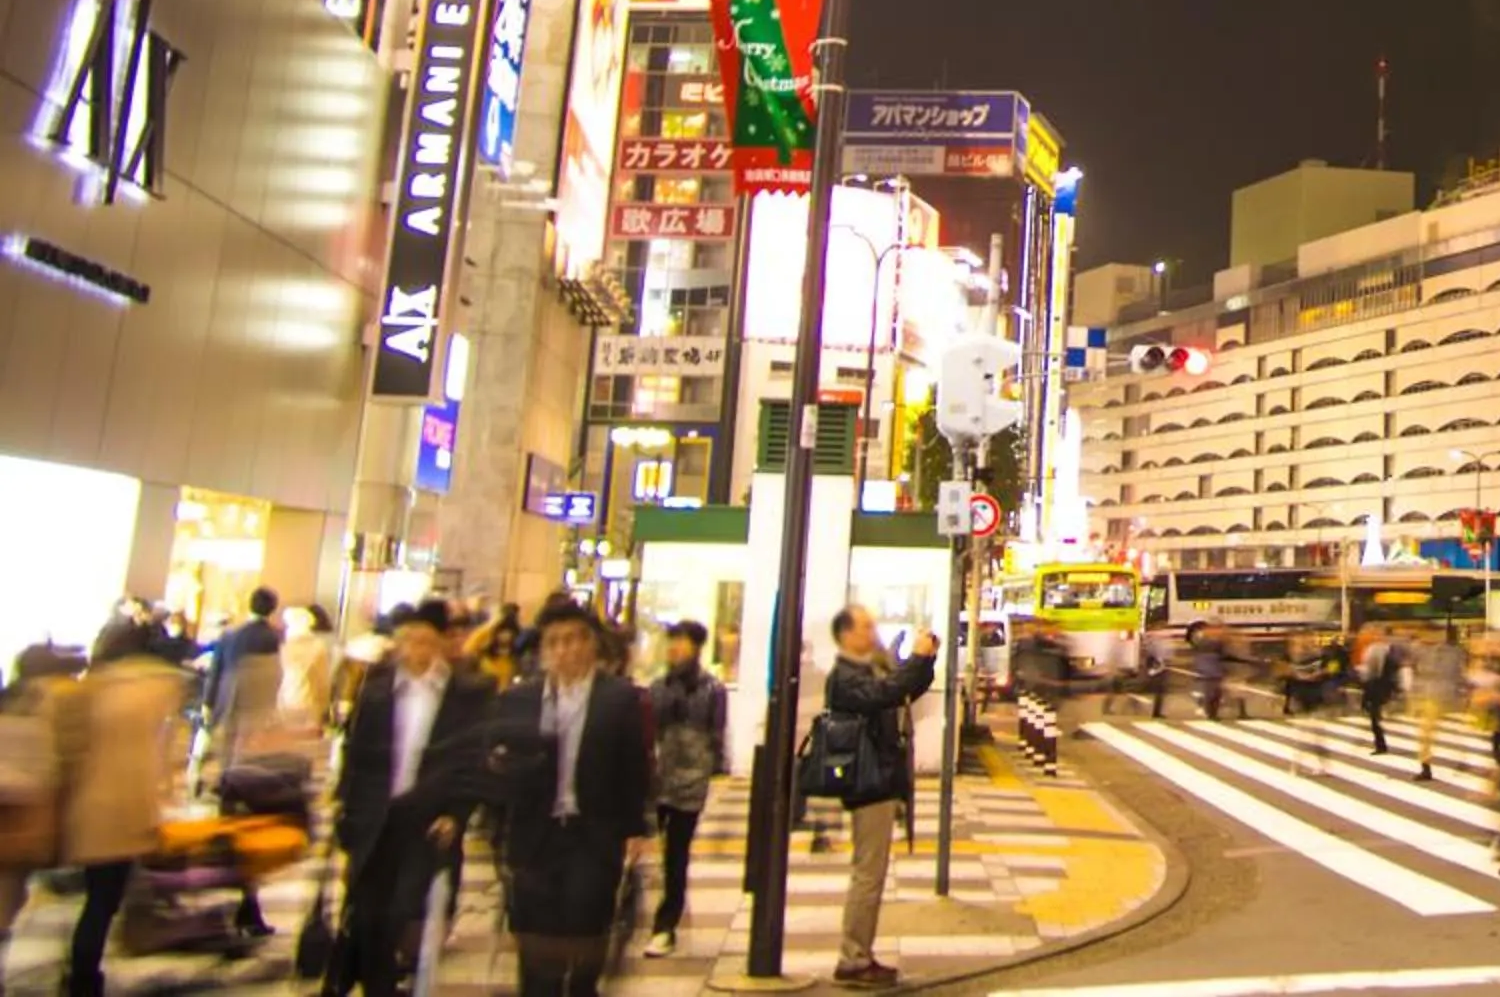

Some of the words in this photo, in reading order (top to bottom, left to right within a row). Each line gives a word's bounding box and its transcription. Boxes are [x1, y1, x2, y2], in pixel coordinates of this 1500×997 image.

[406, 45, 464, 236] ARMANI
[624, 141, 734, 169] カラオケ
